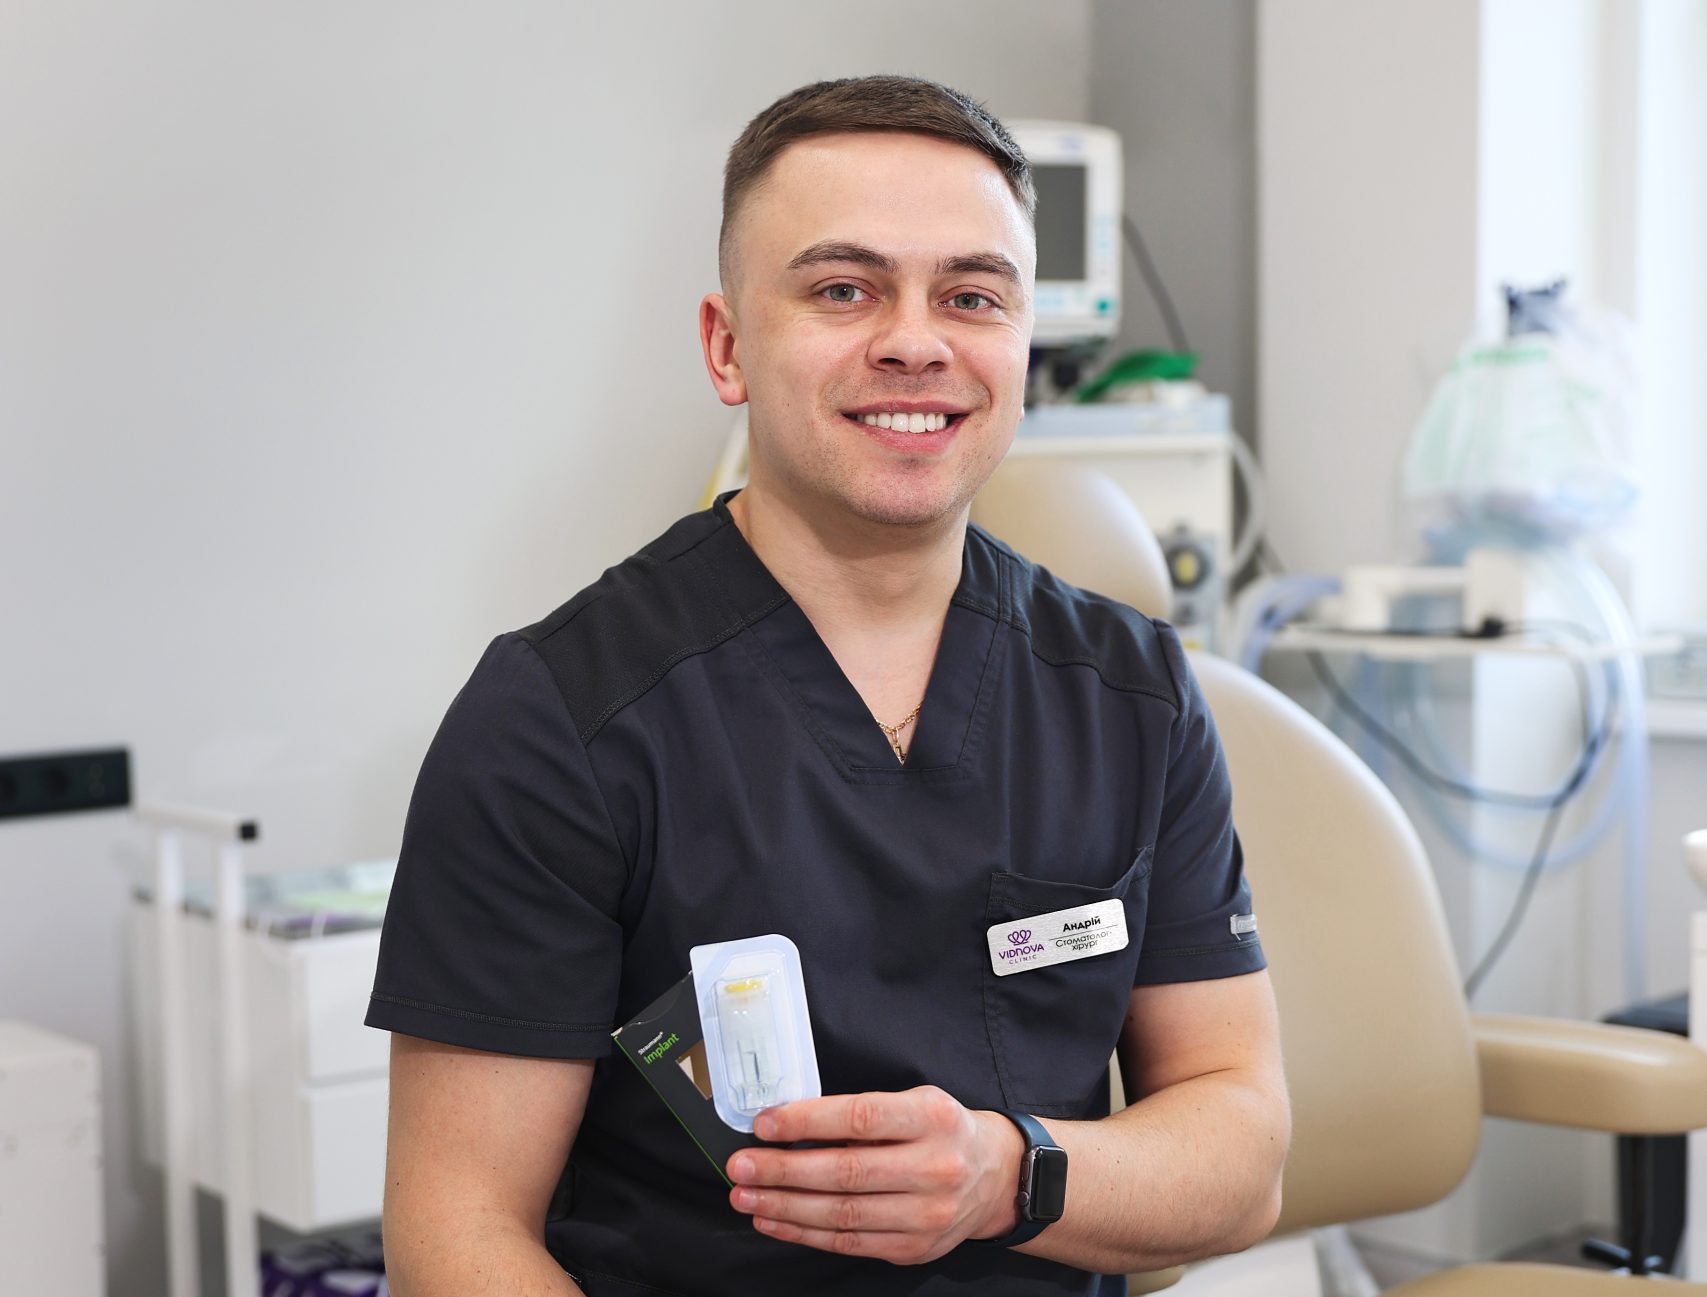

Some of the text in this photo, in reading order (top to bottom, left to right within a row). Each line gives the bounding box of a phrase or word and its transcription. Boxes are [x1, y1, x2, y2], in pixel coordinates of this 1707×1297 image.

[1062, 915, 1101, 933] Андрій
[998, 943, 1045, 959] VIDNOVA
[1072, 940, 1098, 951] хірург
[1008, 954, 1037, 965] CLINIC
[643, 1032, 680, 1064] Implant
